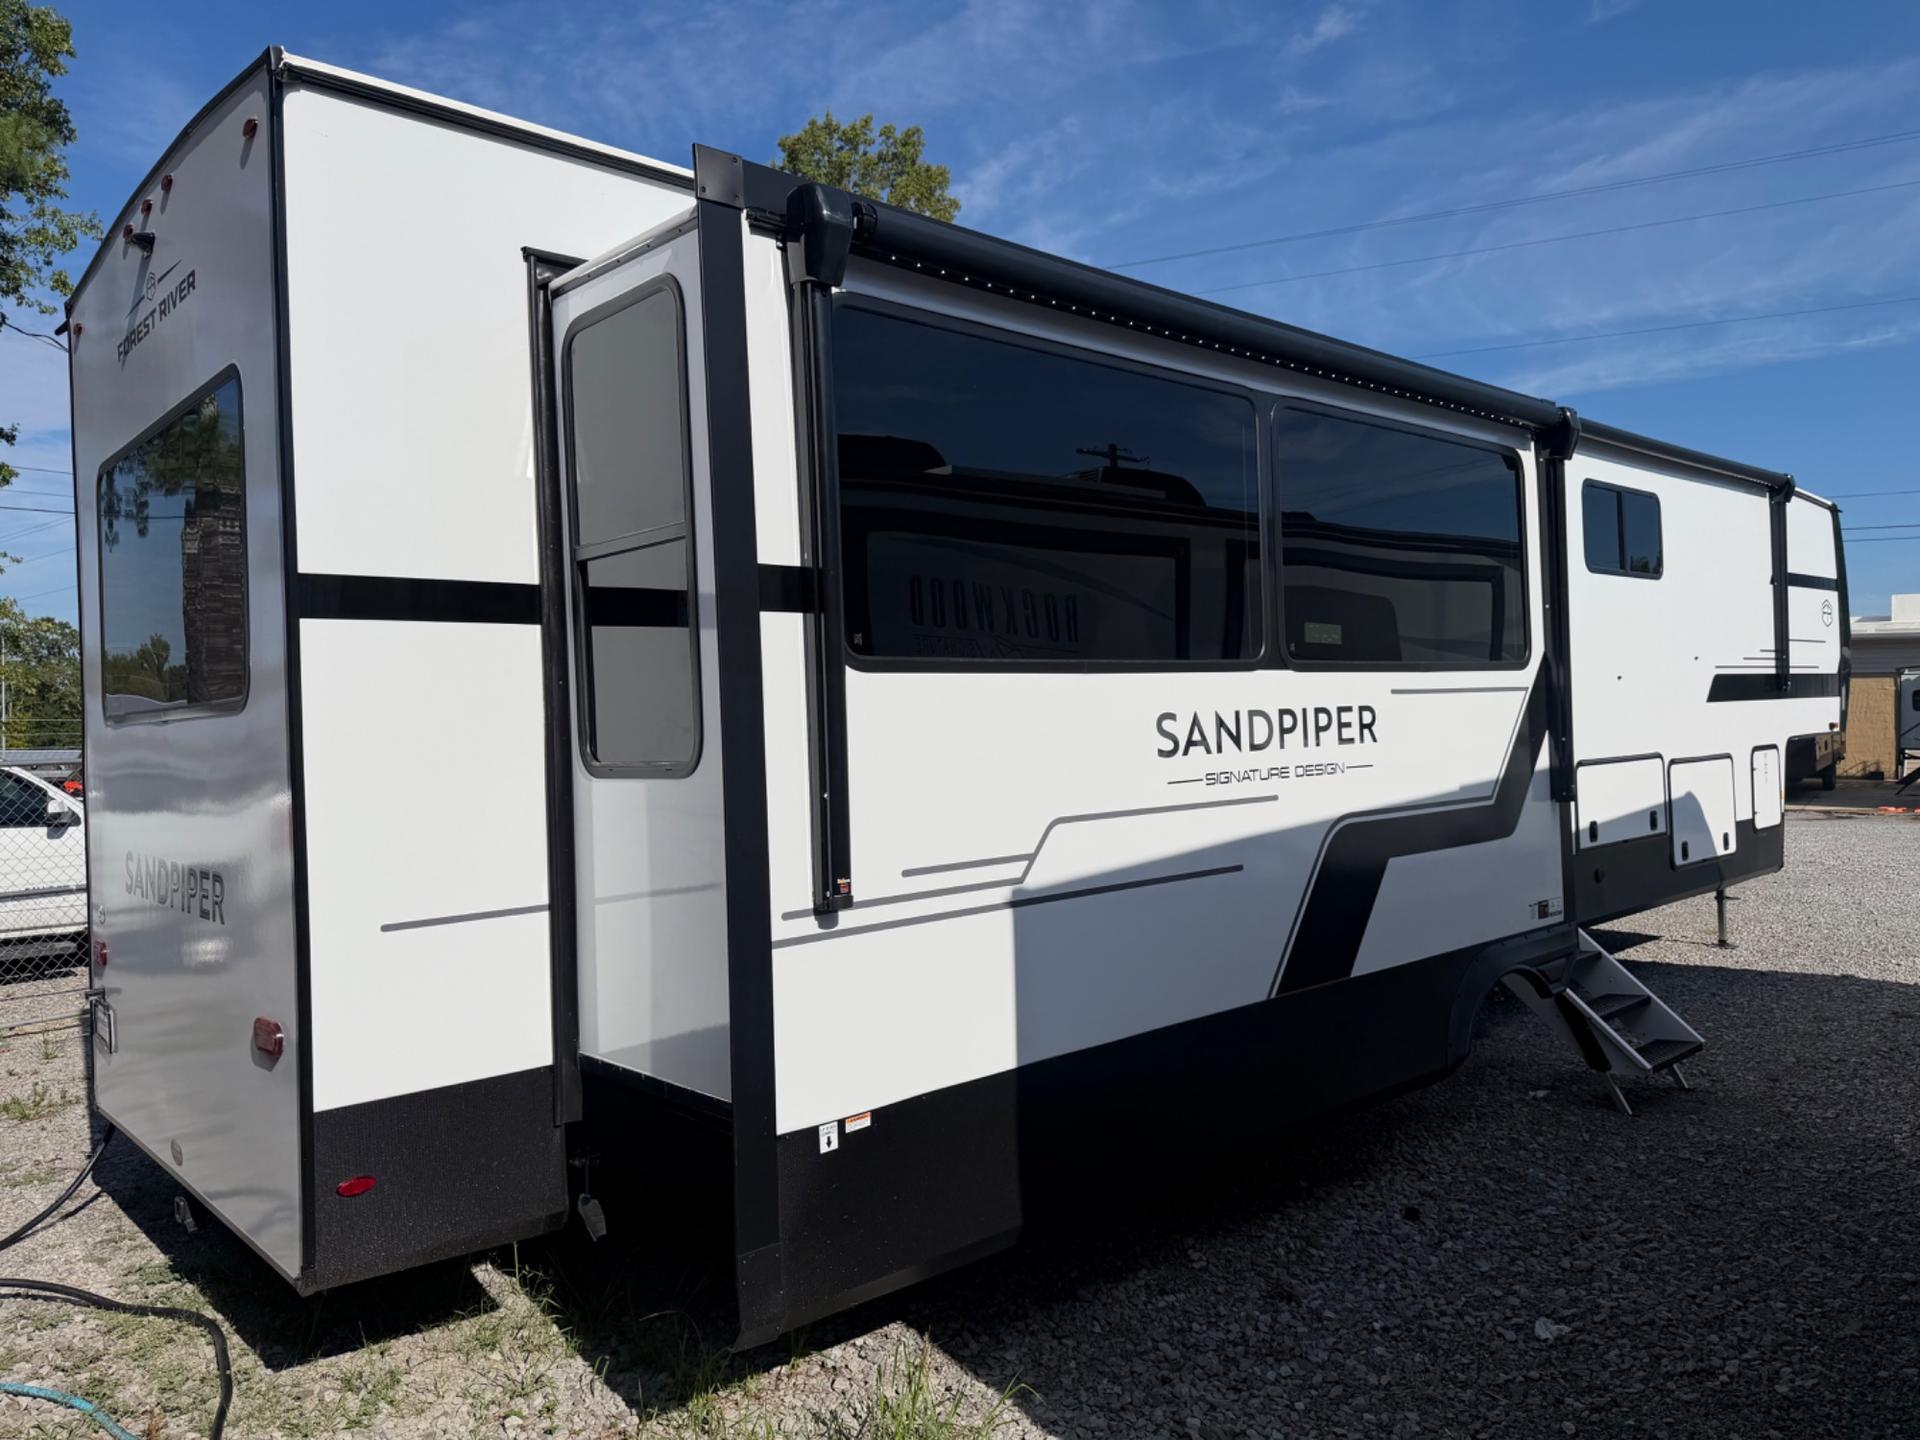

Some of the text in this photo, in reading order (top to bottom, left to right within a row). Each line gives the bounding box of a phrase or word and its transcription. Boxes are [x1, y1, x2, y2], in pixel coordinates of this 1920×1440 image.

[117, 269, 196, 362] FOREST RIVER
[1155, 704, 1378, 759] SANDPIPER
[1205, 762, 1346, 786] SIGNATURE DESIGN
[125, 850, 225, 925] SANDPIPER
